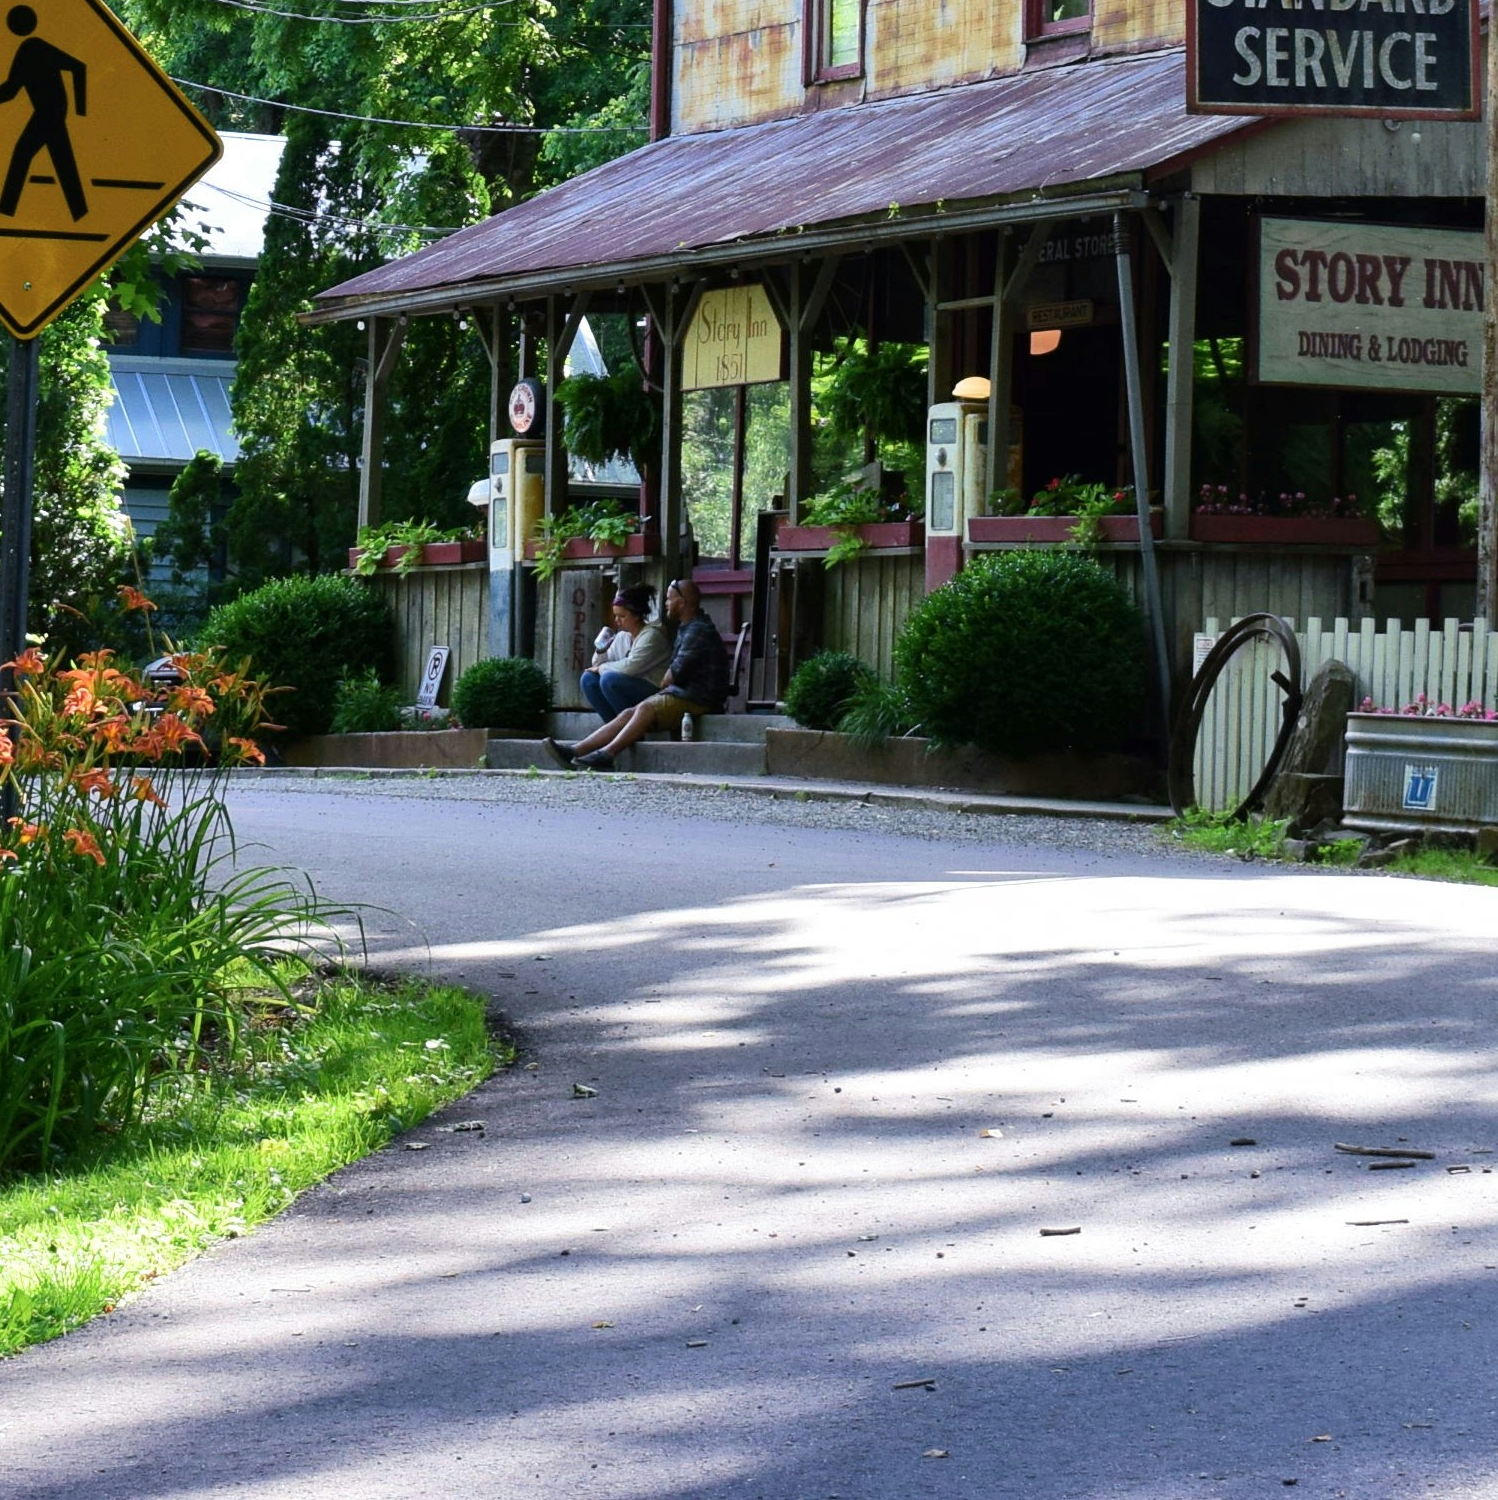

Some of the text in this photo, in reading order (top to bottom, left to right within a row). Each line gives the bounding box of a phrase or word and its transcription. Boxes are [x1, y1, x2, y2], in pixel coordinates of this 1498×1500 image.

[1232, 25, 1438, 91] SERVICE
[1275, 249, 1485, 312] STORY INN
[698, 297, 767, 349] Story Inn
[1298, 331, 1469, 367] DINING & LODGING
[716, 353, 743, 382] 1851
[572, 587, 586, 671] OPEN
